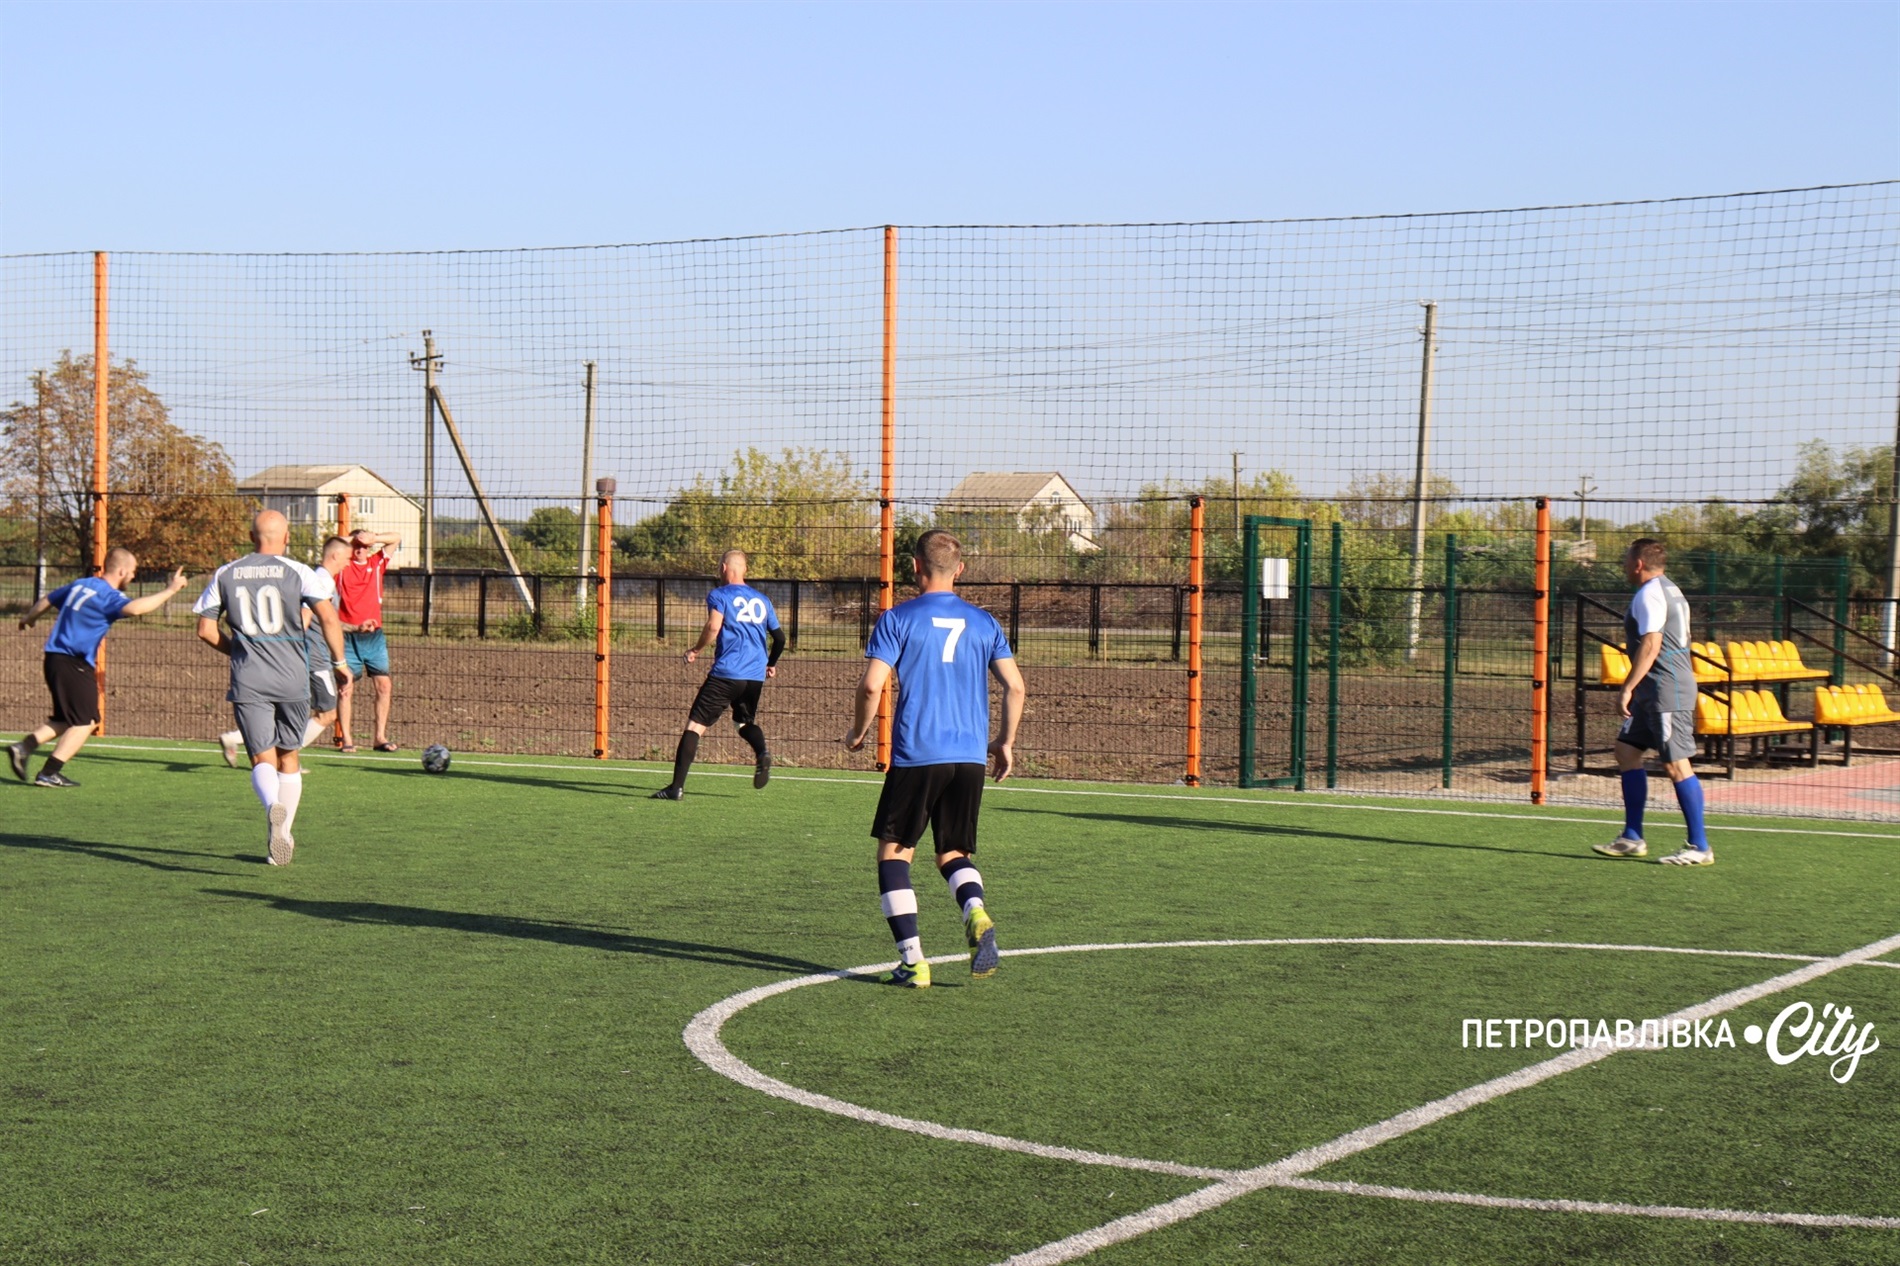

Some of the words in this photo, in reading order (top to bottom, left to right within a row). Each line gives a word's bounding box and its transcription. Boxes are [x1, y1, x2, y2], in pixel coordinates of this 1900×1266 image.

[65, 584, 97, 612] 17
[235, 584, 284, 636] 10
[732, 595, 767, 625] 20
[931, 616, 966, 663] 7
